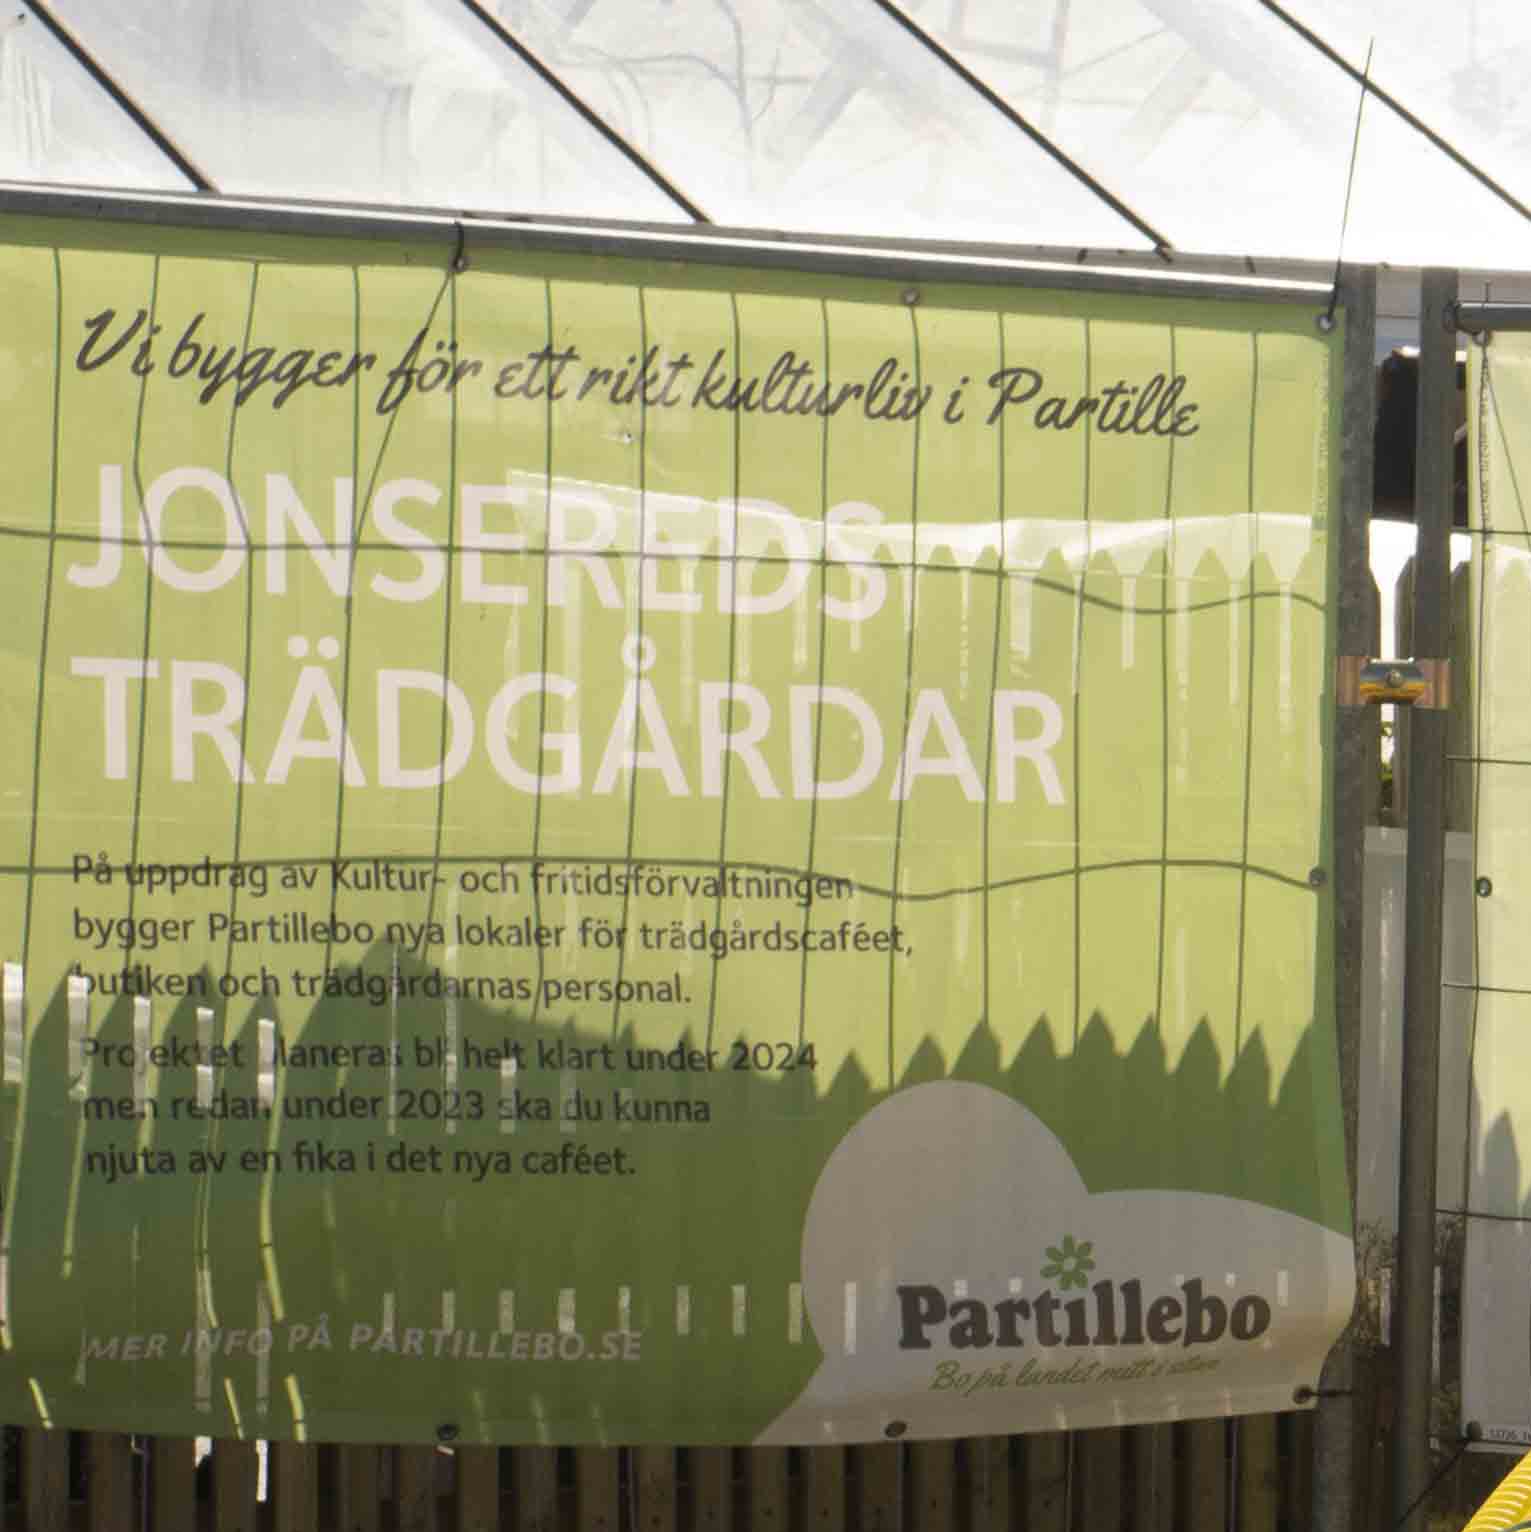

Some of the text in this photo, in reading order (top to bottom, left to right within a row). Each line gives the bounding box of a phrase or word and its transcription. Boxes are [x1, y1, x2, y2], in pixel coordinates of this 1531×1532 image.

[76, 308, 1201, 438] Vi bygger för ett rikt kulturliv i Partille
[66, 463, 889, 620] JONSEREDS
[70, 632, 1067, 806] TRÄDGÅRDAR
[72, 852, 854, 906] På uppdrag av Kultur- och fritidsförvaltningen
[73, 908, 913, 960] bygger Partillebo nya lokaler för trädgårdscaféet,
[218, 965, 280, 997] och
[543, 972, 692, 1008] personal.
[463, 1038, 525, 1069] helt
[538, 1039, 617, 1071] klart
[625, 1039, 718, 1072] under
[731, 1042, 817, 1072] 2024
[285, 1090, 382, 1120] under
[397, 1089, 485, 1120] 2023
[563, 1091, 602, 1122] du
[616, 1091, 711, 1122] kunna
[87, 1142, 636, 1183] njuta av en fika i det nya caféet.
[84, 1312, 642, 1361] MER INFO PÅ PARTILLEBO.SE
[896, 1277, 1272, 1349] Partillebo
